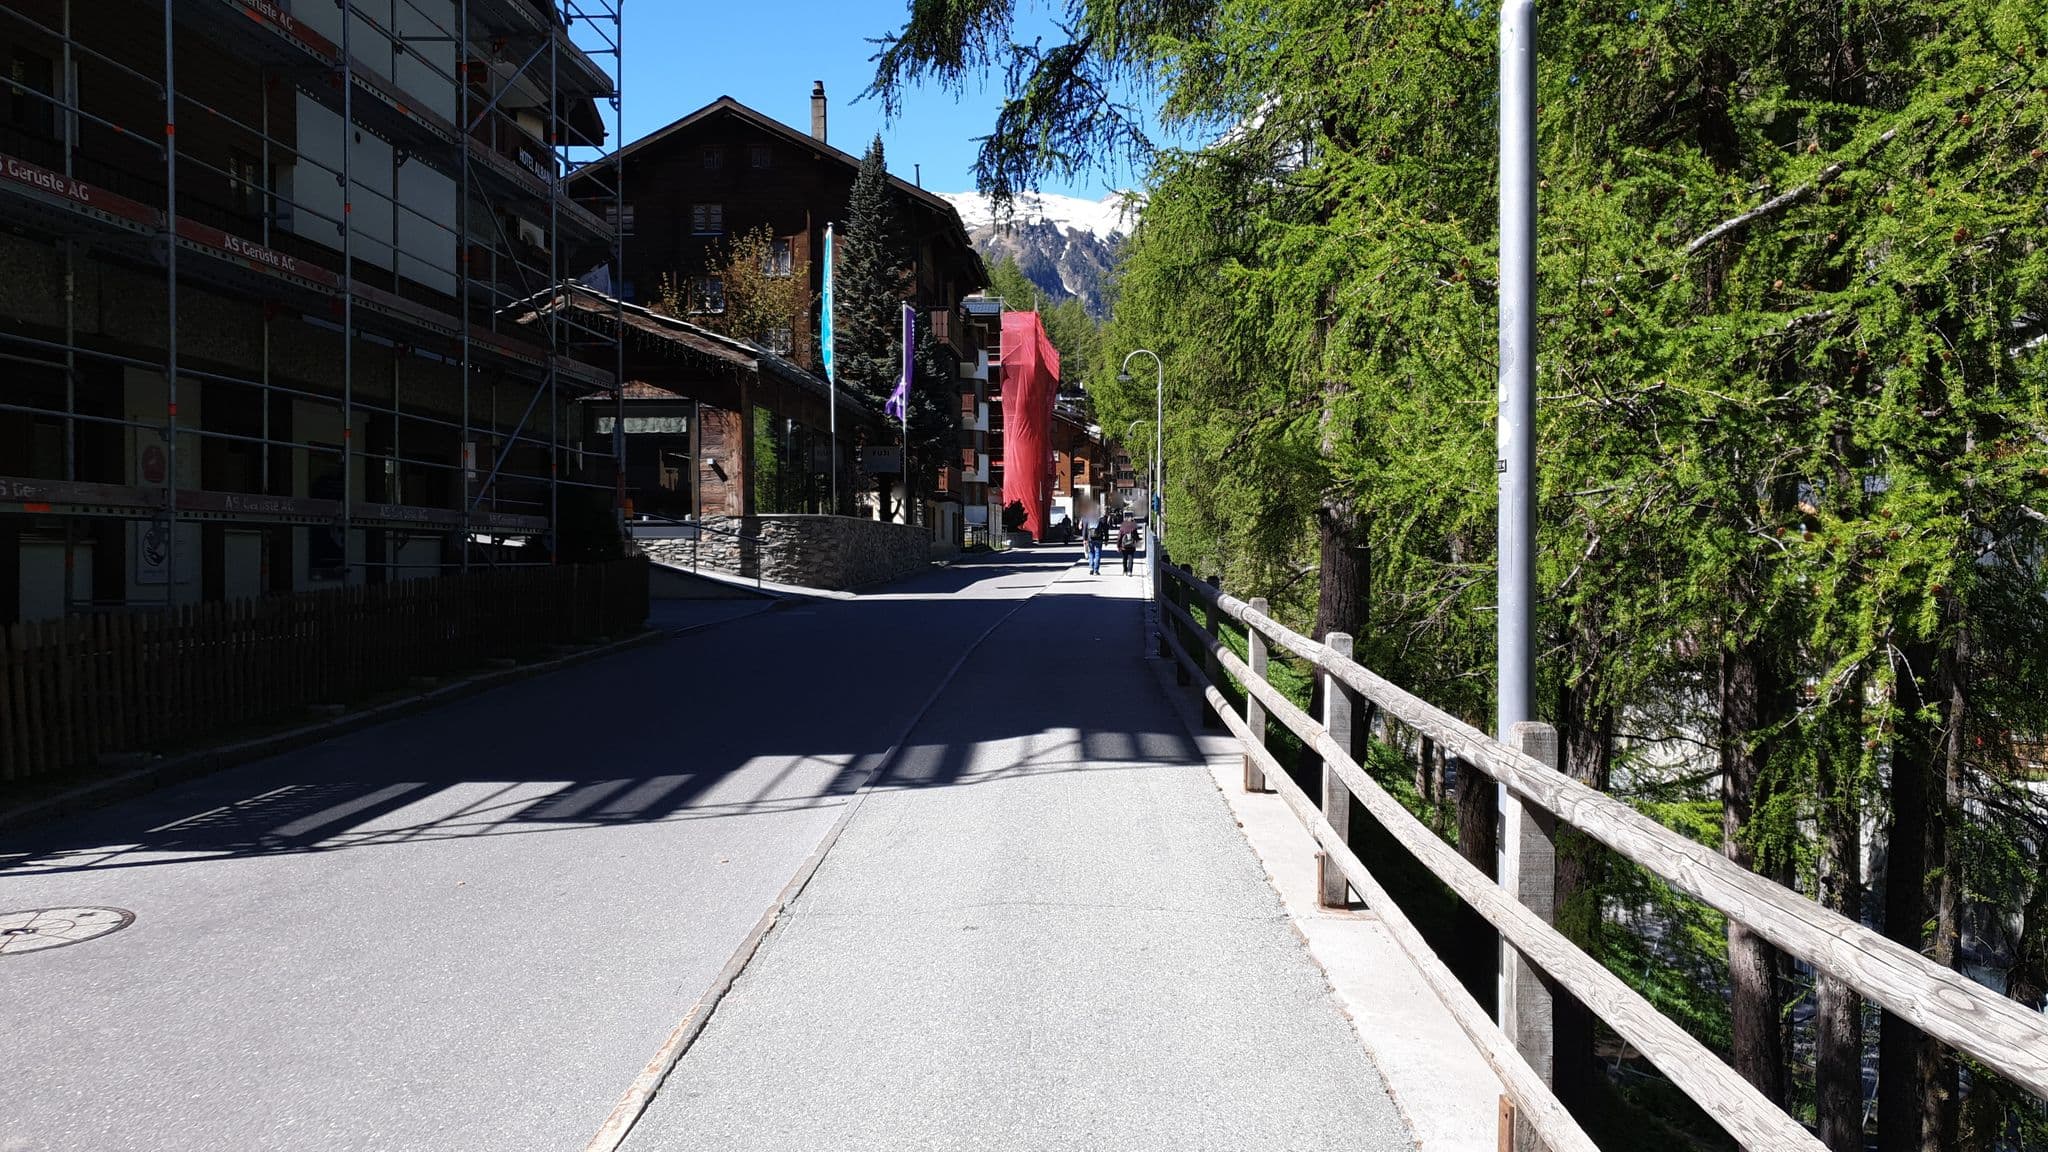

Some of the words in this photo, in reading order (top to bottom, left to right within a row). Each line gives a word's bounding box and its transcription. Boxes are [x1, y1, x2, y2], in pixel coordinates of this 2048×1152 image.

[279, 12, 293, 32] AG
[68, 181, 89, 202] AG
[224, 235, 239, 252] AS
[281, 255, 295, 271] AG
